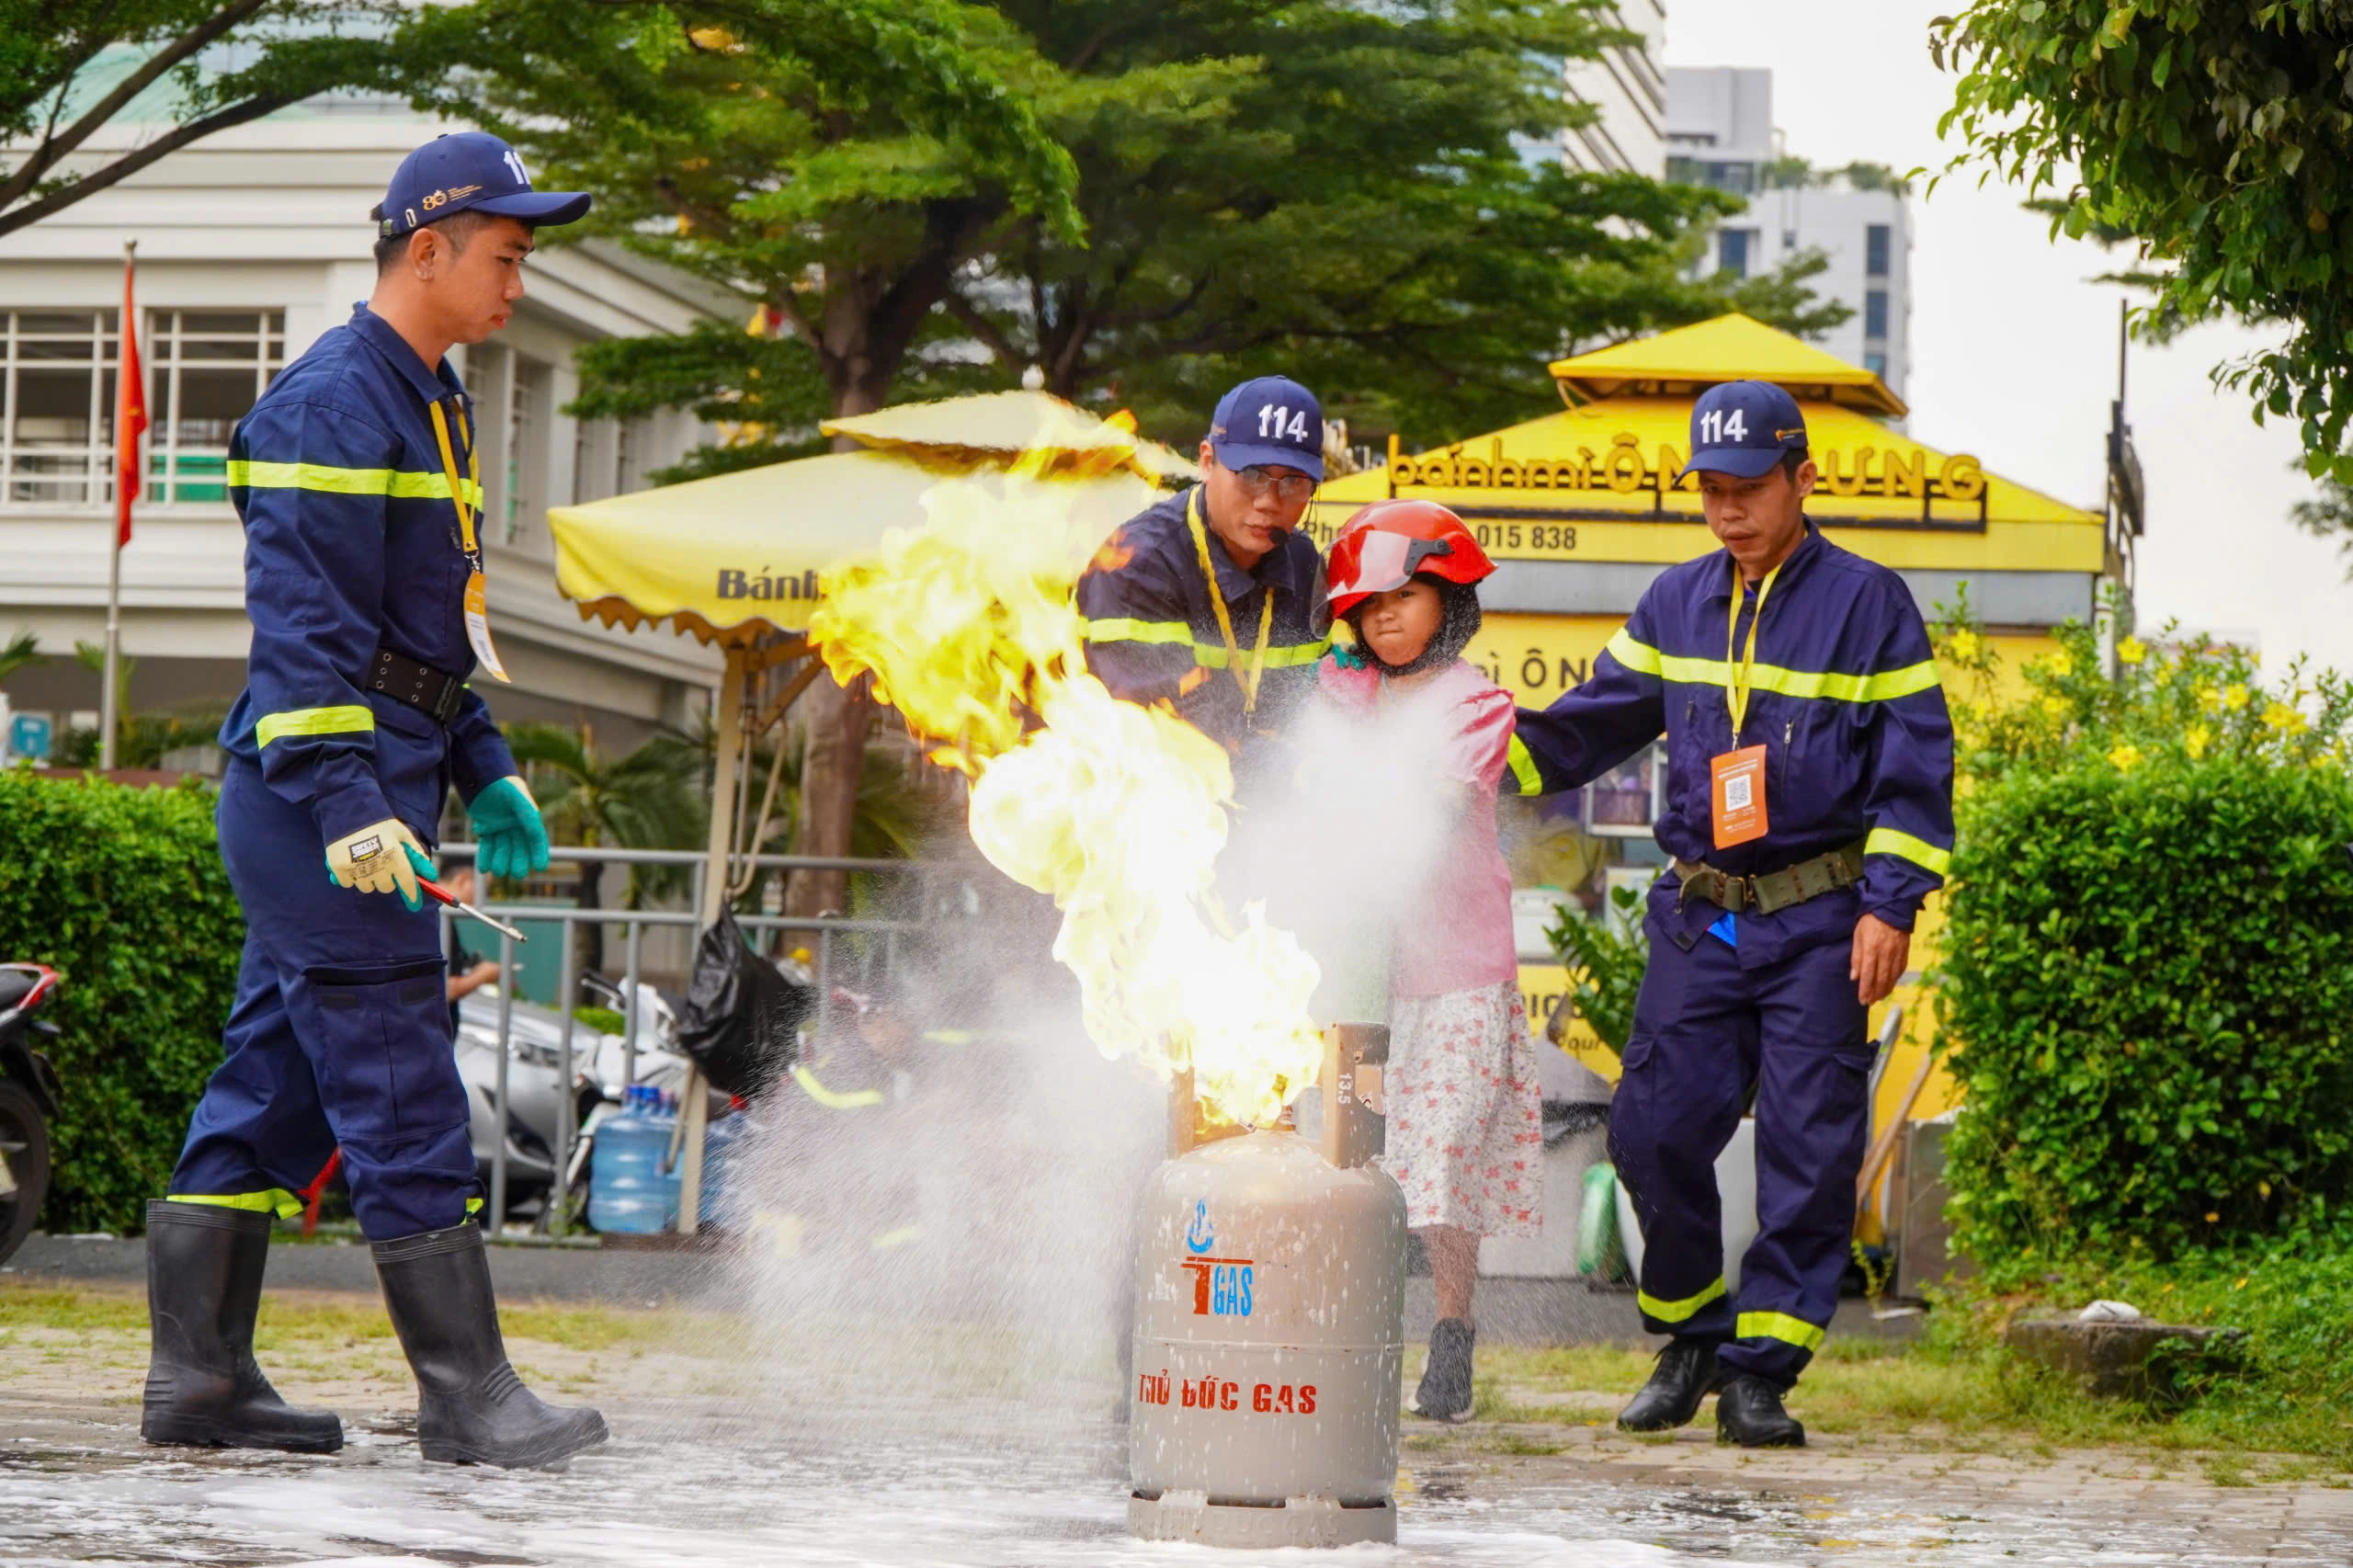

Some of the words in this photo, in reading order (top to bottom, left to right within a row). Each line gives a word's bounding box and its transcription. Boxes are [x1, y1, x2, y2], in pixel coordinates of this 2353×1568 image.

[503, 150, 530, 185] 11
[1258, 403, 1309, 443] 114
[1700, 408, 1748, 444] 114
[1605, 432, 1700, 494] ÔN
[1825, 446, 1985, 500] ƯNG
[1476, 524, 1522, 548] 015
[1531, 525, 1577, 550] 838
[1252, 1383, 1317, 1415] GAS
